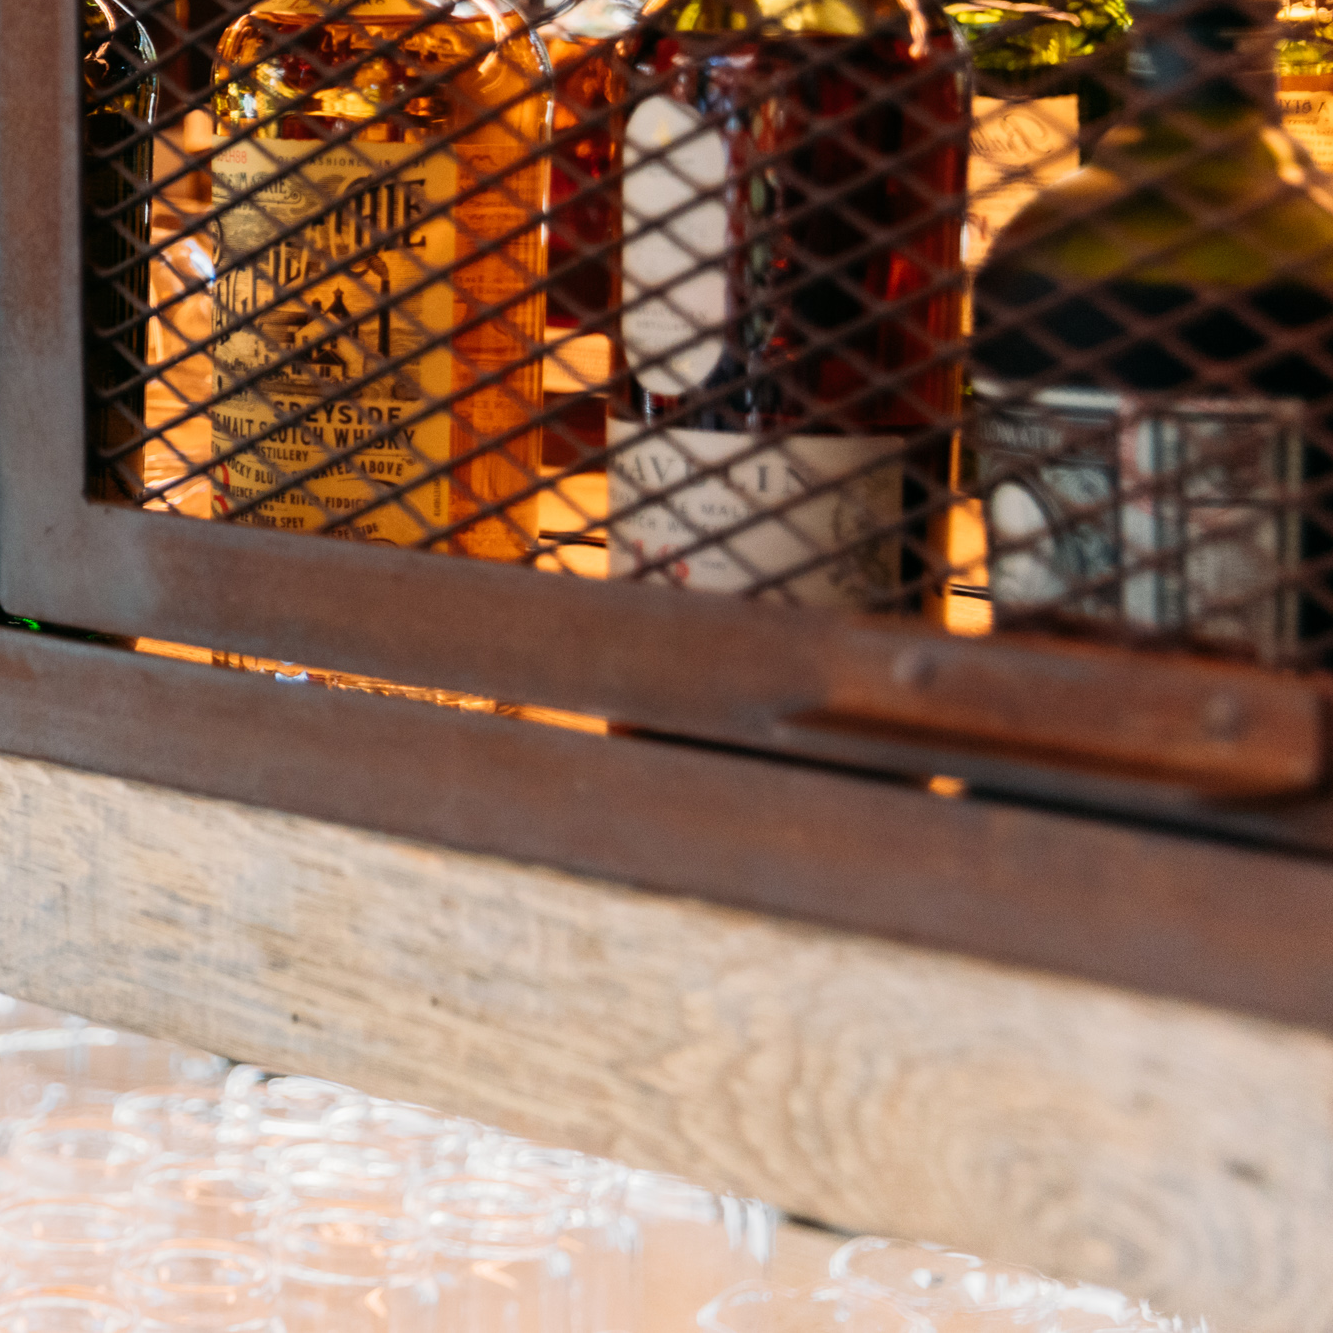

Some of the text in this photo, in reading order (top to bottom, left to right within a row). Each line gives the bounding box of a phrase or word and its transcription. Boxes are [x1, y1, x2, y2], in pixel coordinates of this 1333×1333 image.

[223, 416, 254, 439] MALT
[359, 460, 404, 477] ABOVE
[280, 517, 305, 530] SPEY
